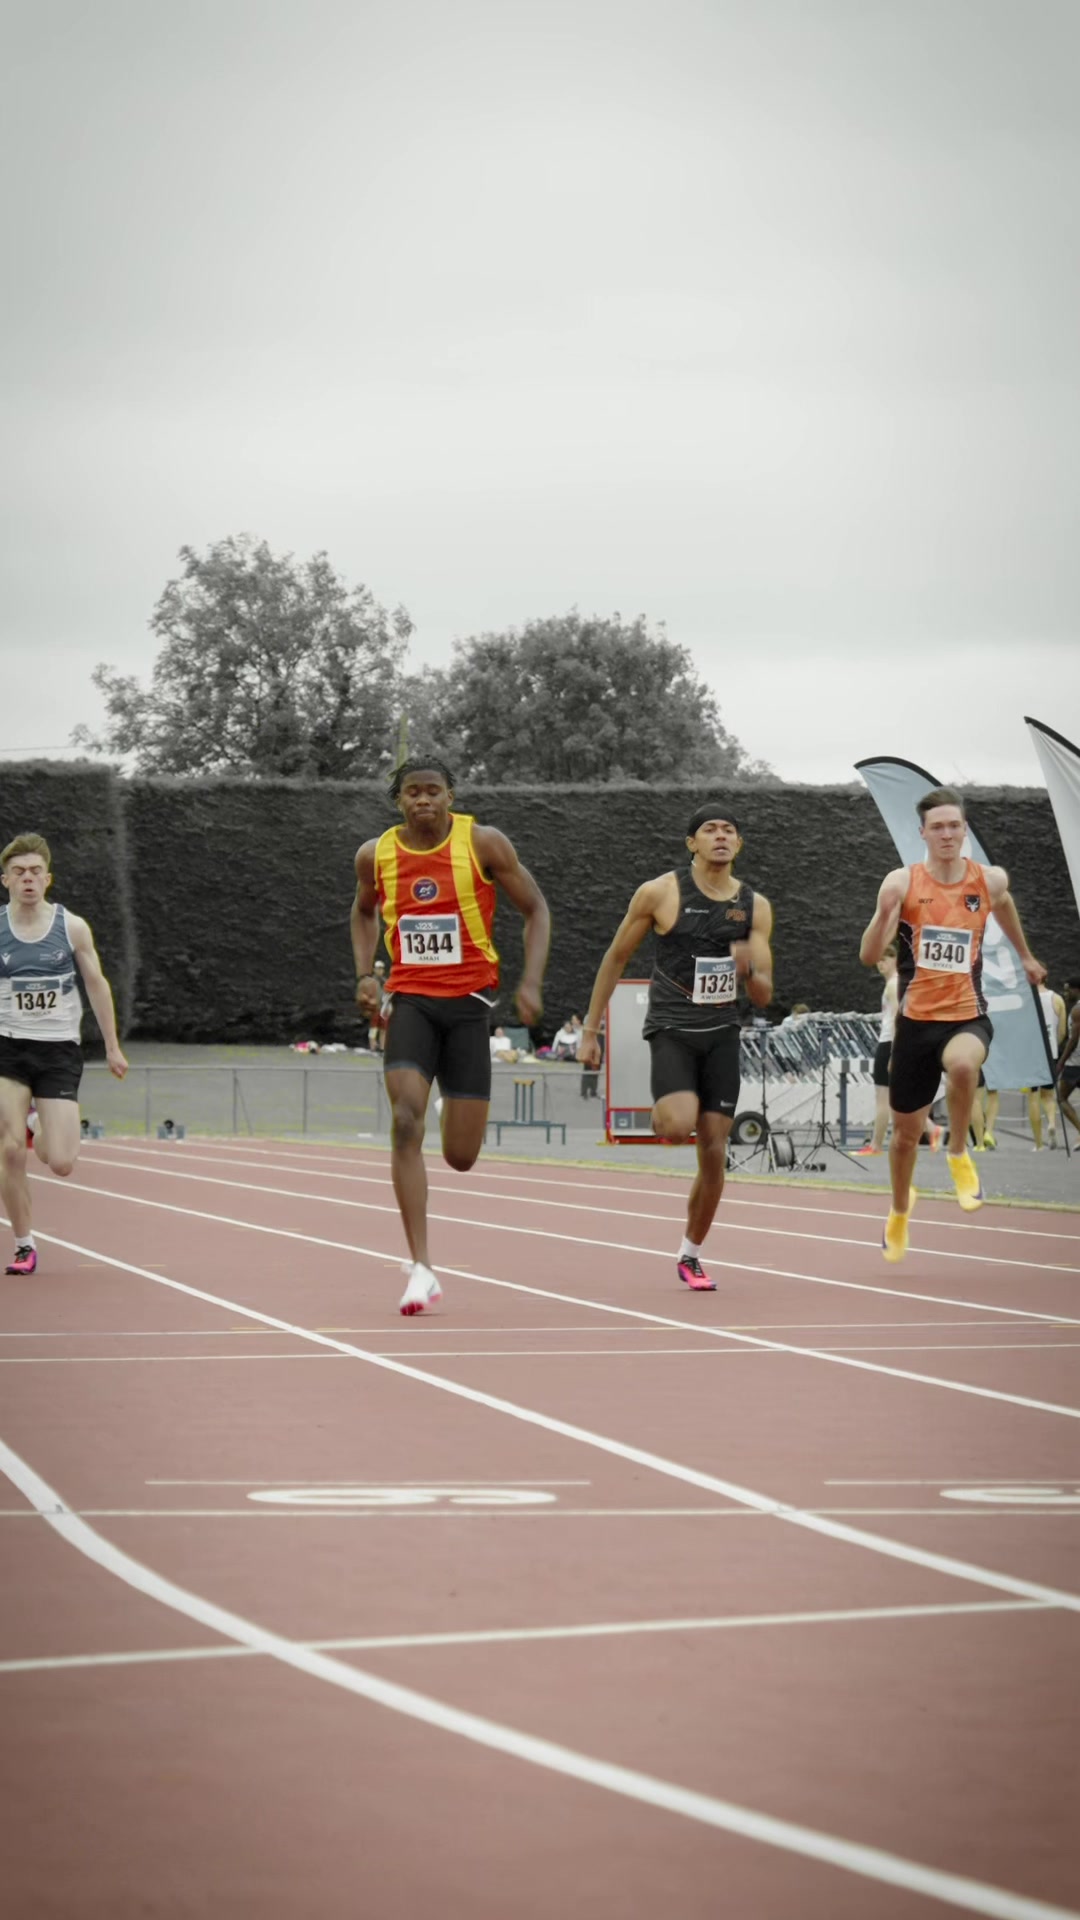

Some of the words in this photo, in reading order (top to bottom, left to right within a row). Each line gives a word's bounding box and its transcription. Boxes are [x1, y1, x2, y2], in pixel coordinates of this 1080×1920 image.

[404, 933, 453, 954] 1344
[923, 942, 965, 963] 1340
[698, 972, 735, 994] 1325
[15, 991, 57, 1010] 1342
